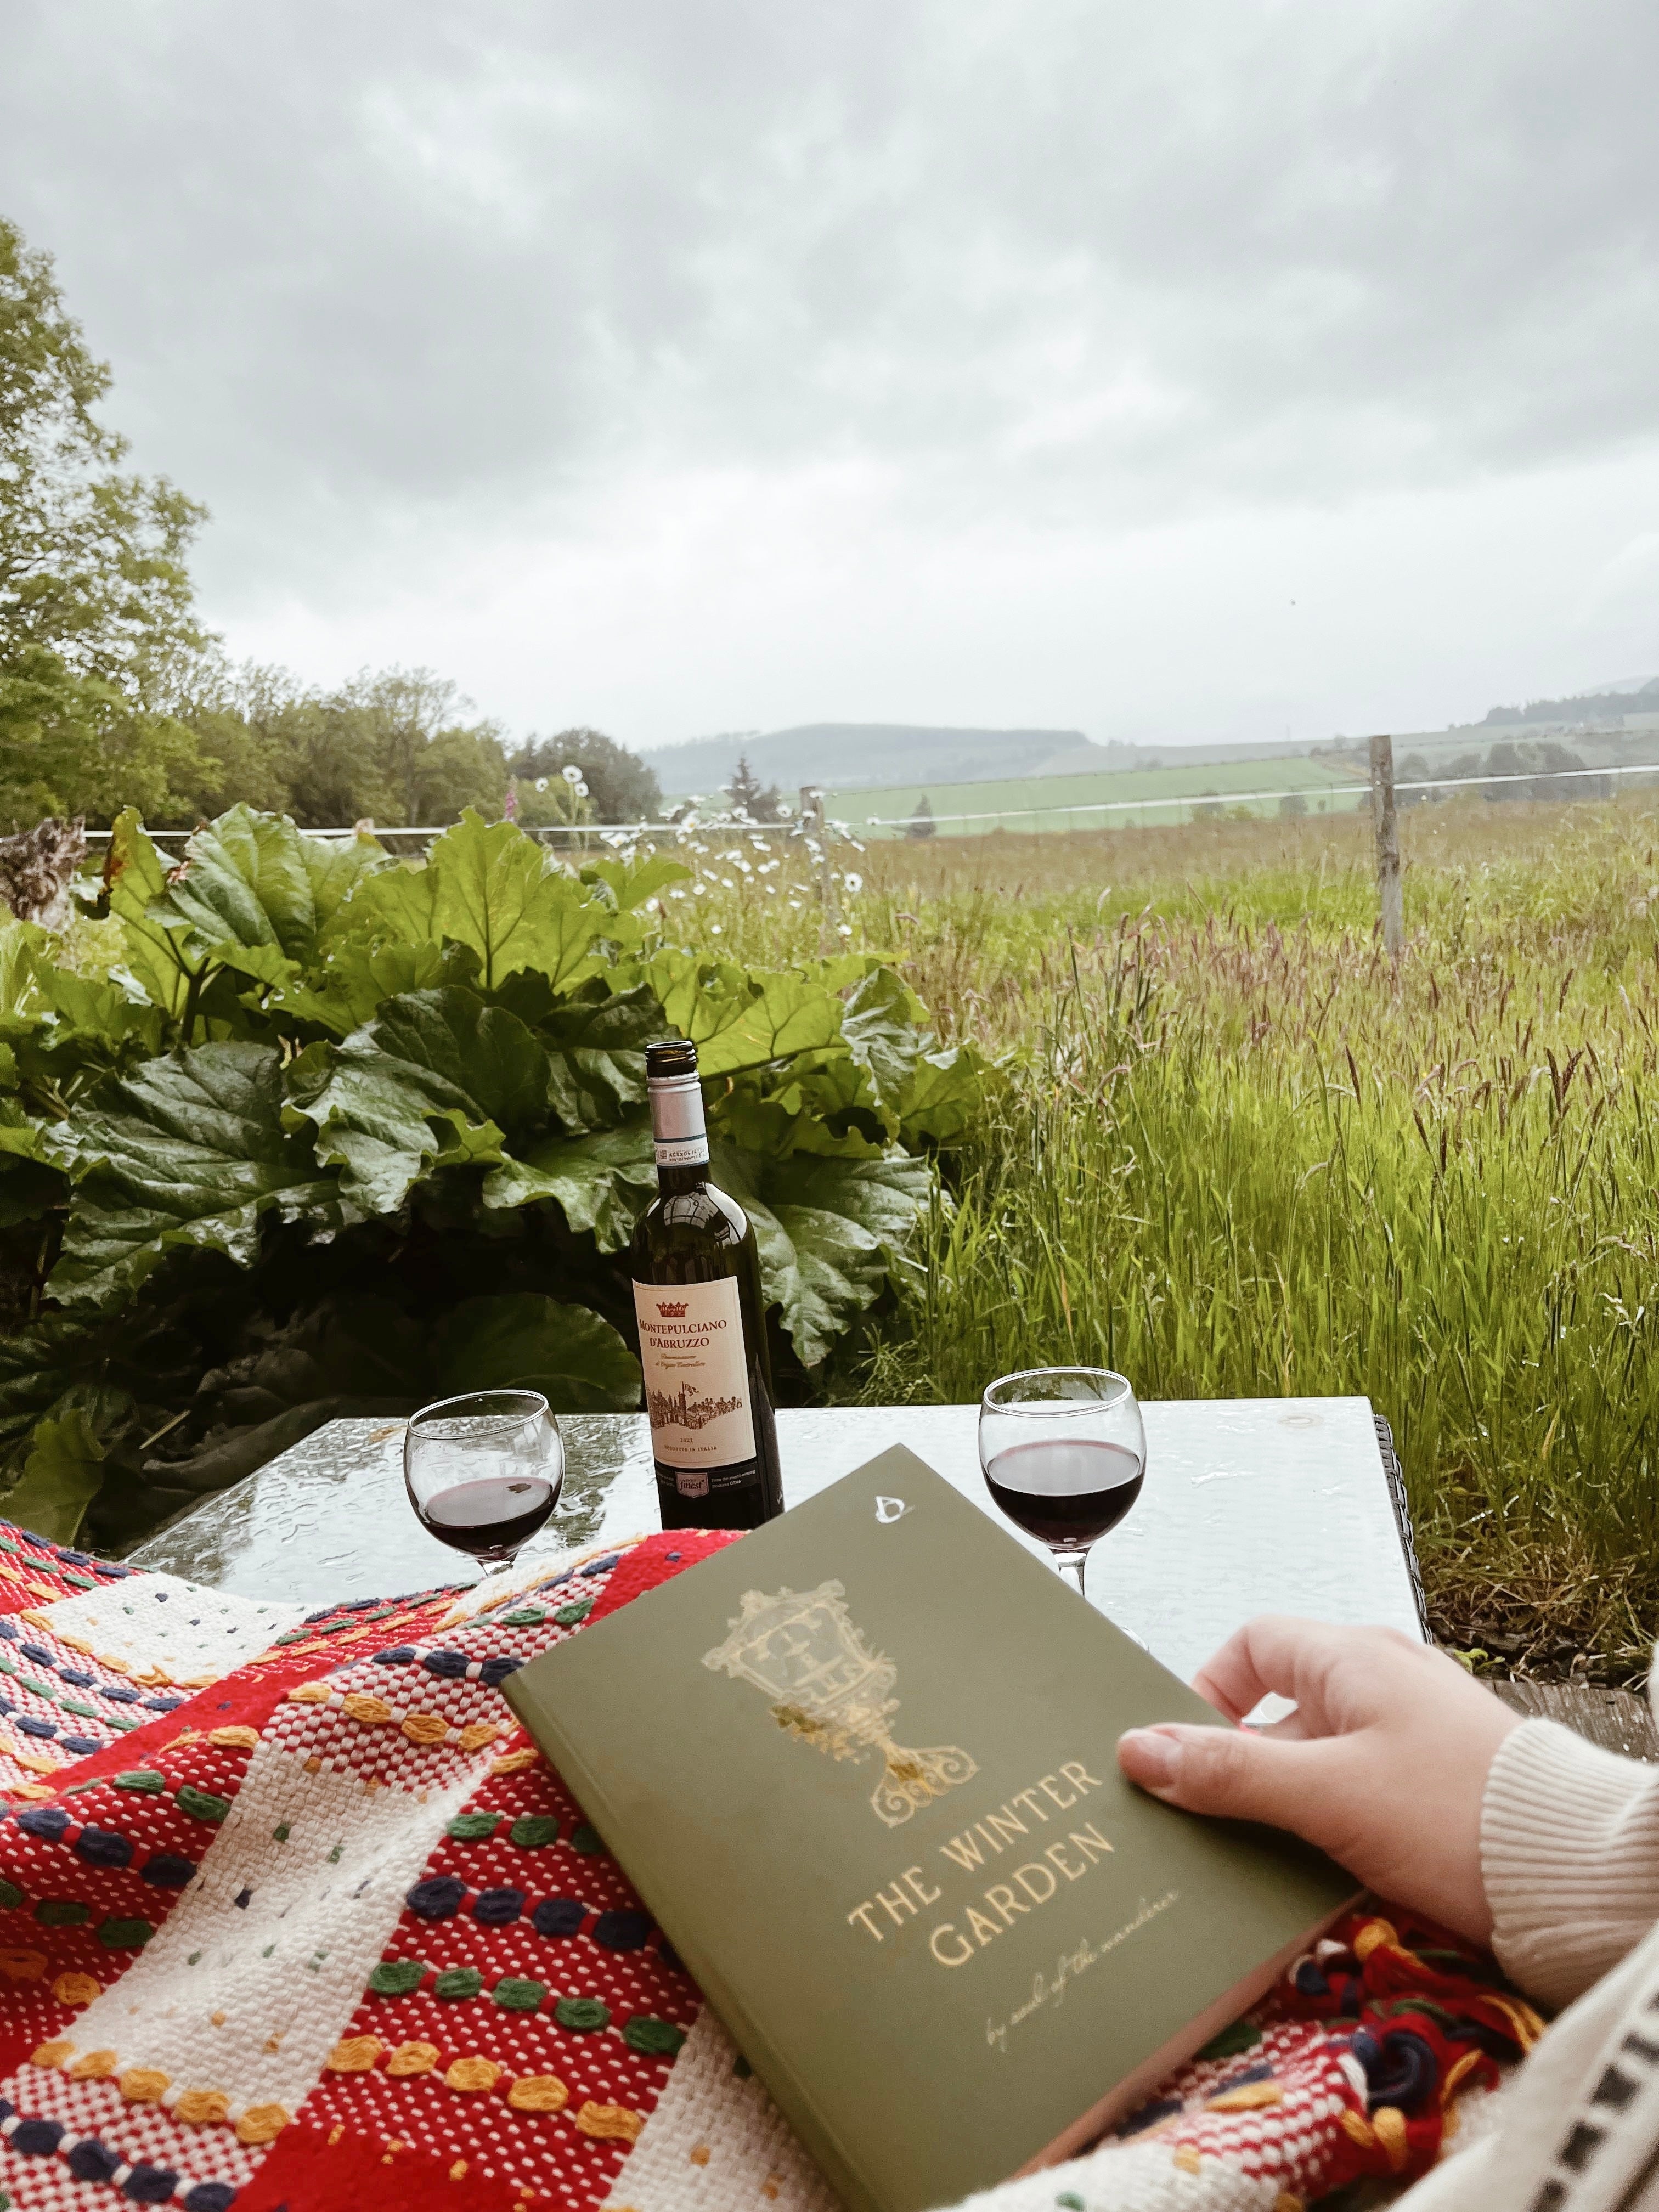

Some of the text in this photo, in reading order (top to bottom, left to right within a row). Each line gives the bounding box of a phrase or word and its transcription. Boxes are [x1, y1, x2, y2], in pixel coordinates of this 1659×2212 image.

[640, 1319, 727, 1334] MONTEPULCIANO
[650, 1337, 710, 1348] D'ABRUZZO
[848, 1760, 1102, 1942] THE WINTER
[930, 1822, 1115, 1966] GARDEN
[987, 2017, 1006, 2053] by
[1051, 1955, 1069, 2008] of
